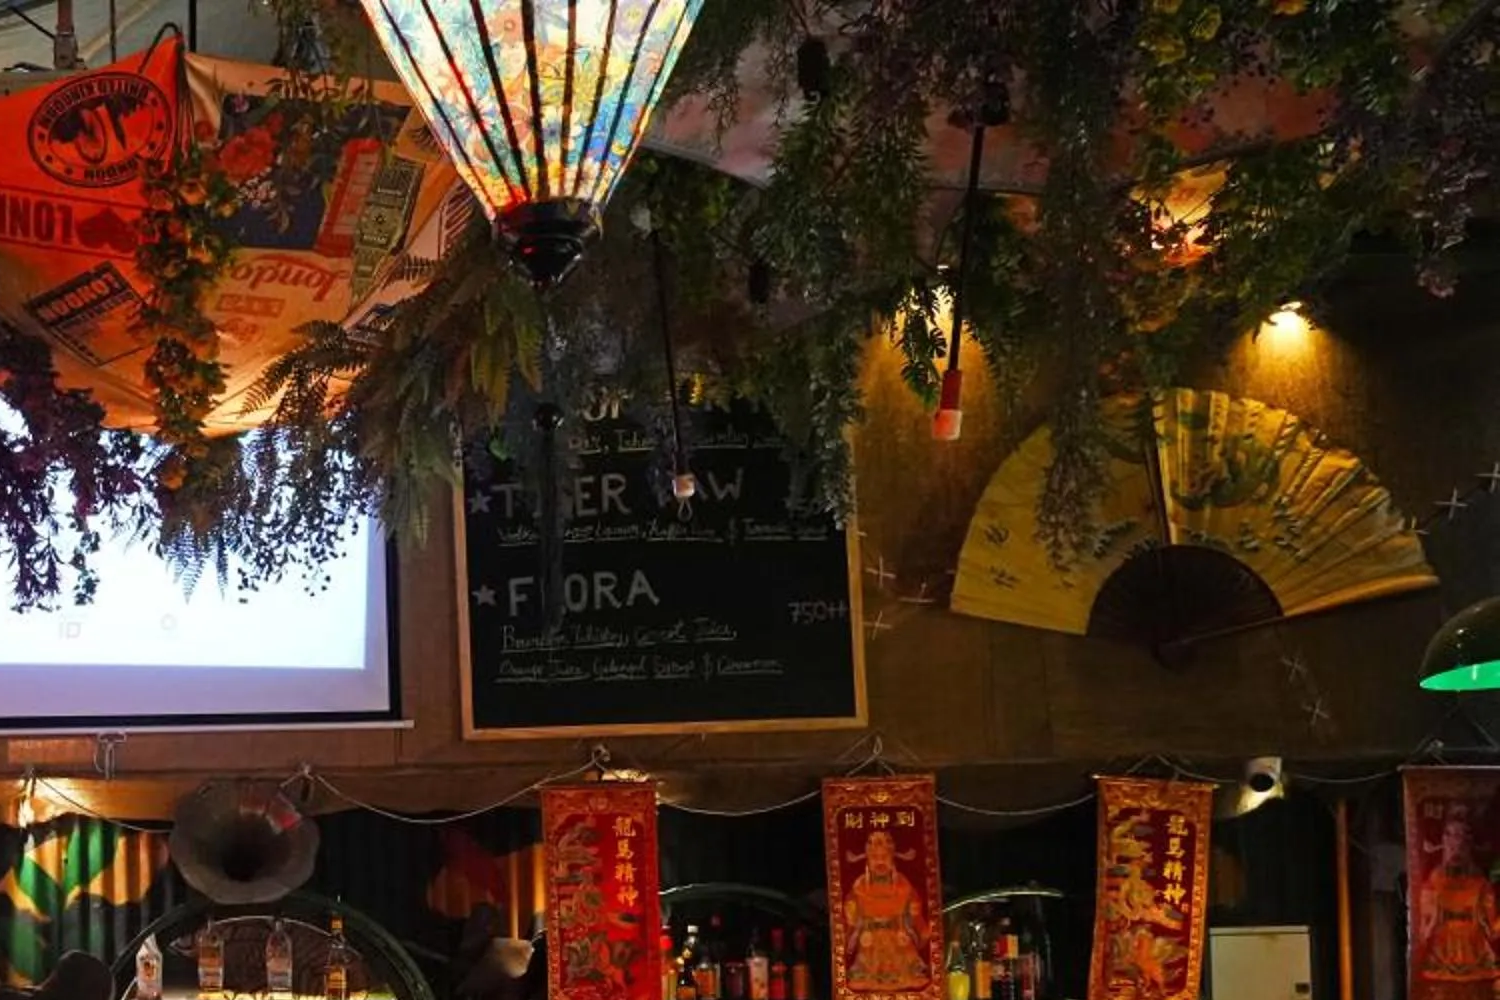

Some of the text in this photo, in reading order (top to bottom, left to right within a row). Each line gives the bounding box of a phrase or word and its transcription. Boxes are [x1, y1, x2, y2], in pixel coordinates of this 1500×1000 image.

[37, 271, 121, 321] LONDON
[232, 256, 338, 302] Londo
[508, 570, 660, 616] FORA
